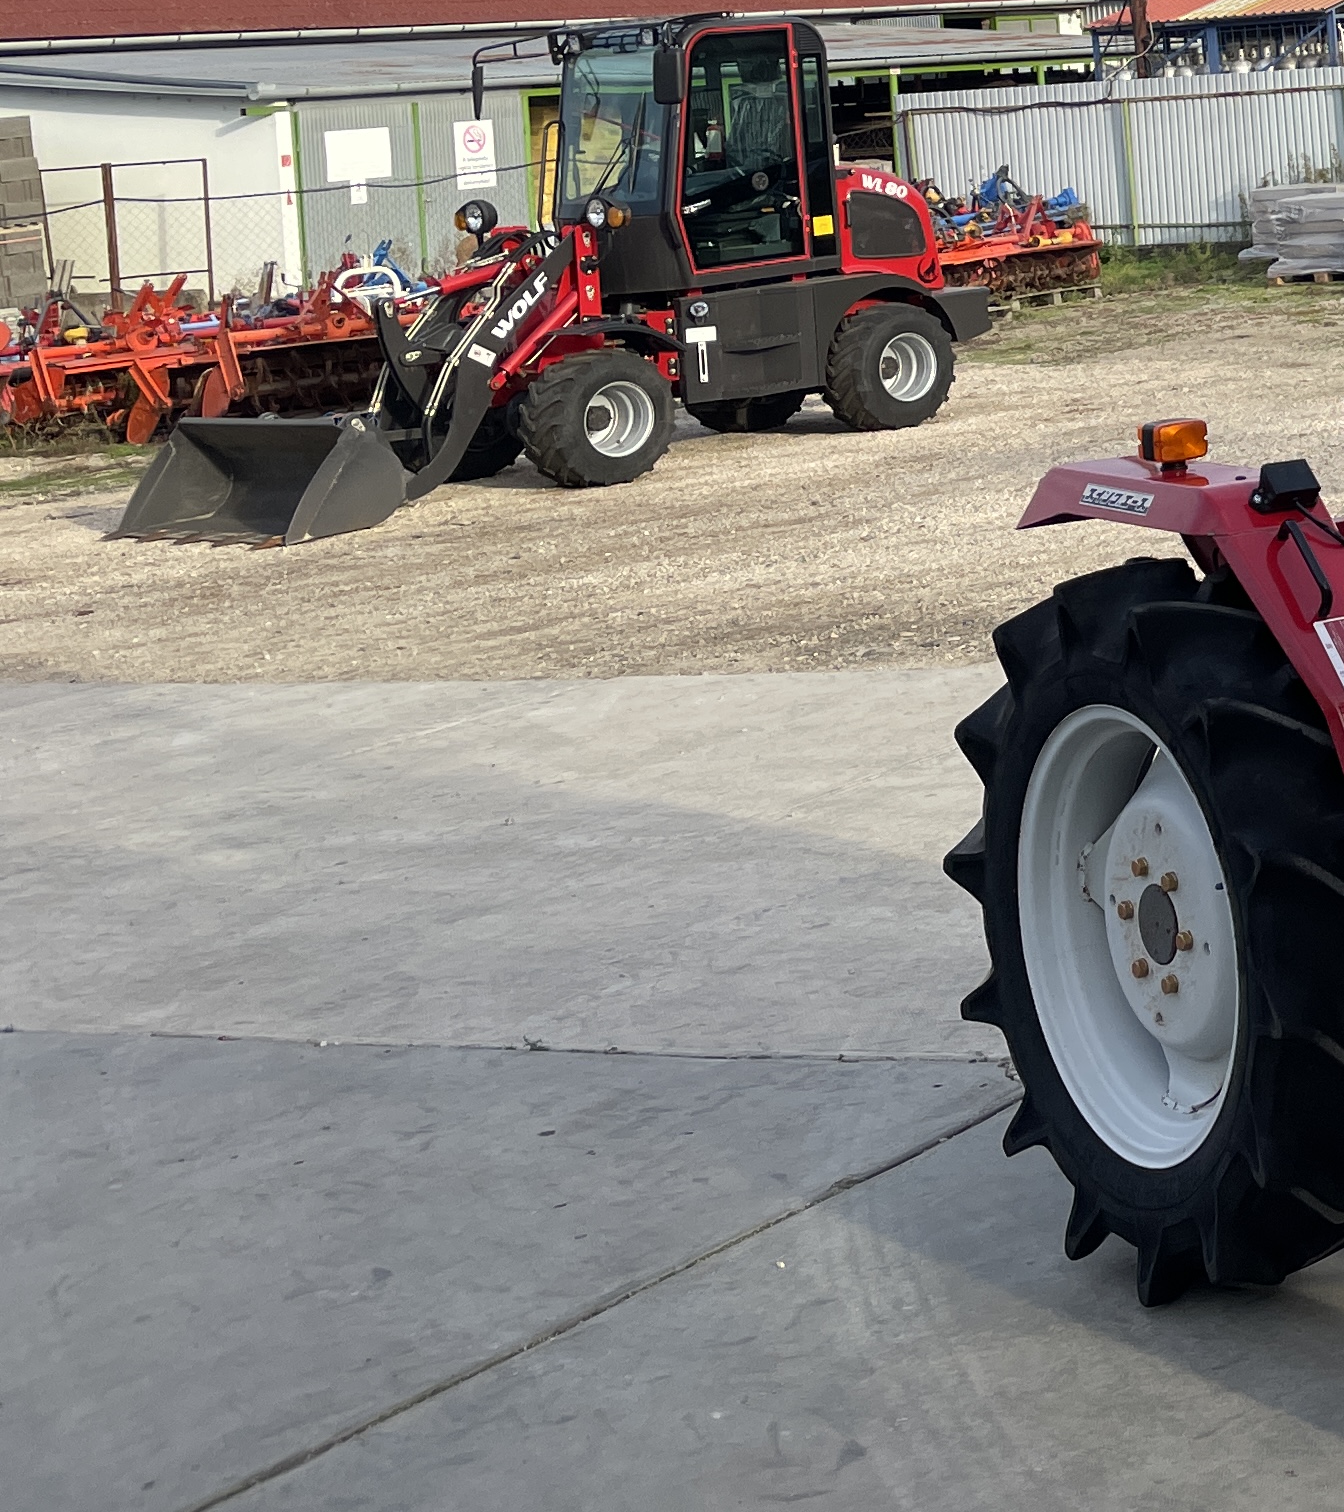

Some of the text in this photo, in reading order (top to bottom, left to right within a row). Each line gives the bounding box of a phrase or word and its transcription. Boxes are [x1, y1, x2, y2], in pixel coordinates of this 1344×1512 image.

[861, 174, 908, 198] WL 80
[491, 271, 548, 339] WOLF
